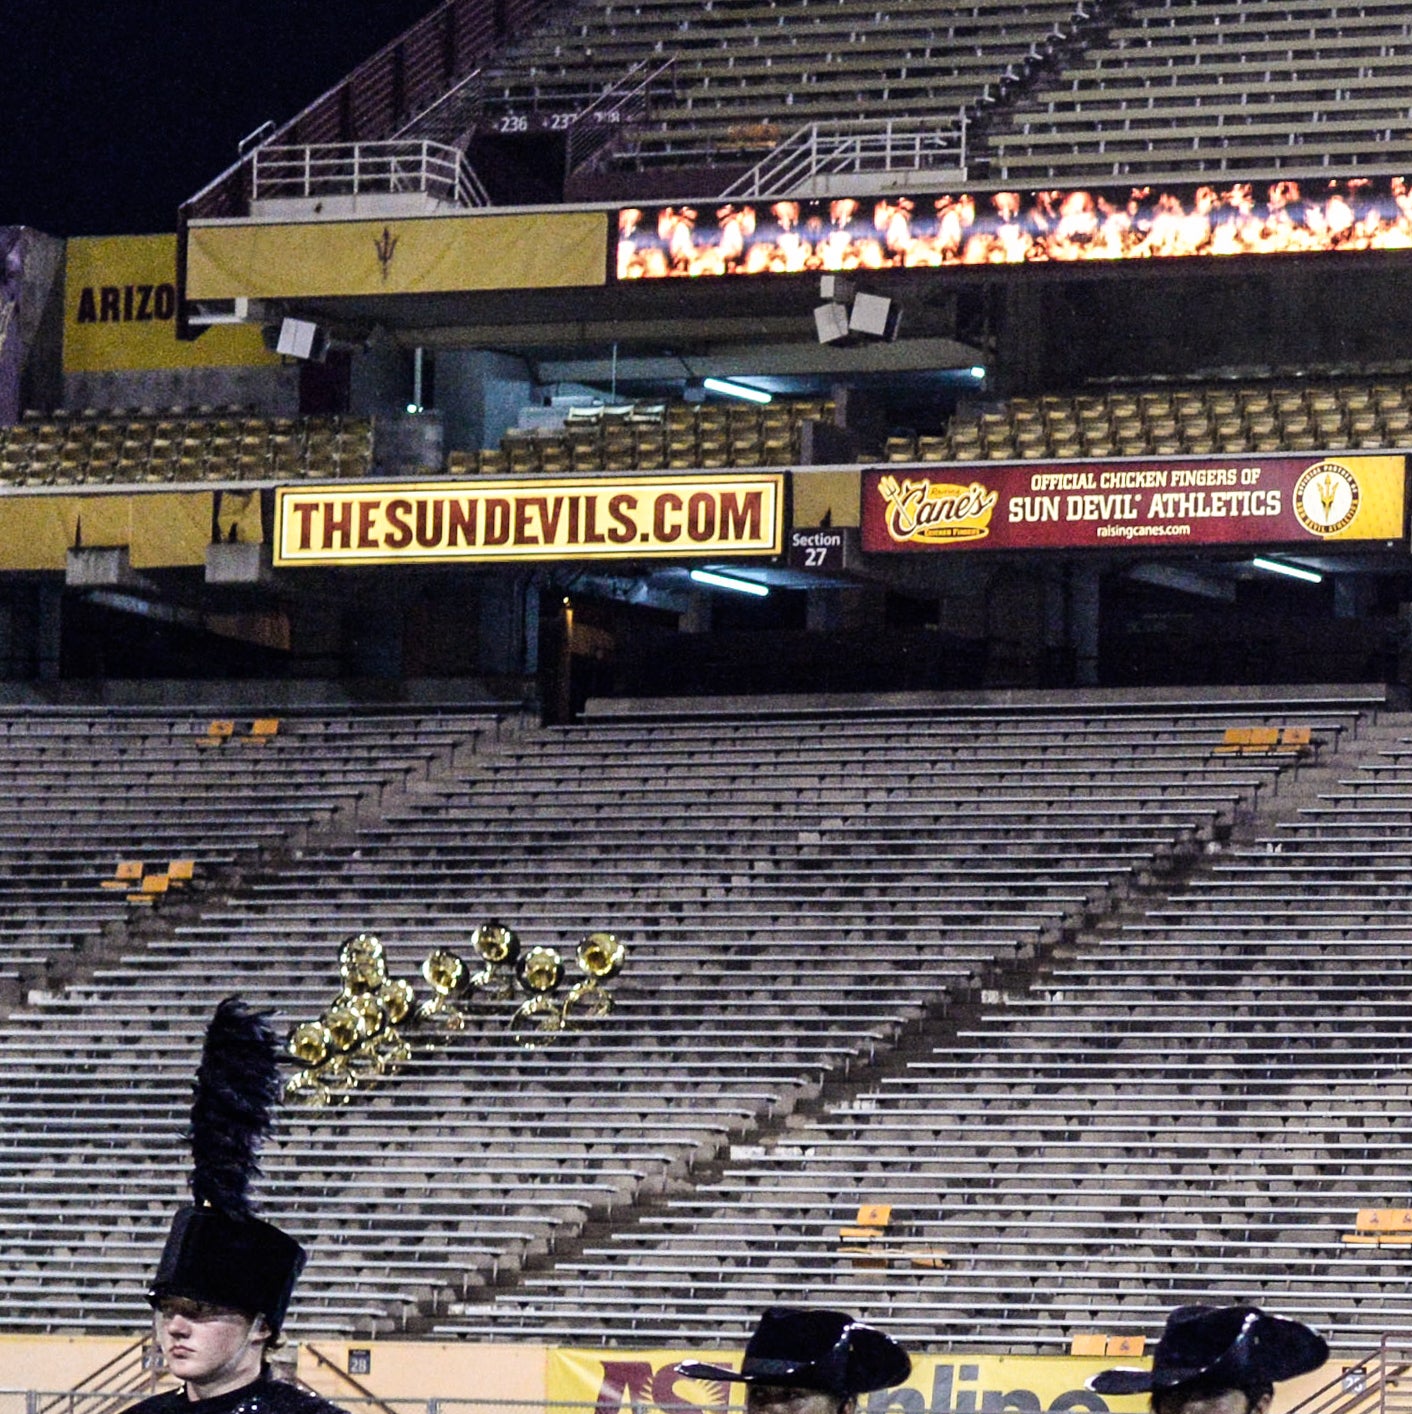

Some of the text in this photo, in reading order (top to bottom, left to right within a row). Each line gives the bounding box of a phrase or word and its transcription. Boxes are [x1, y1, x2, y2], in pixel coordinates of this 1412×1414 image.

[501, 116, 527, 132] 236
[77, 283, 175, 323] ARIZO
[1030, 468, 1261, 491] OFFICIAL CHICKEN FINGERS OF
[1008, 497, 1060, 523] SUN
[1147, 490, 1282, 518] ATHLETICS
[292, 491, 762, 550] THESUNDEVILS.COM
[792, 532, 841, 547] Section
[1097, 524, 1190, 539] raisingcanes.com
[805, 547, 828, 566] 27
